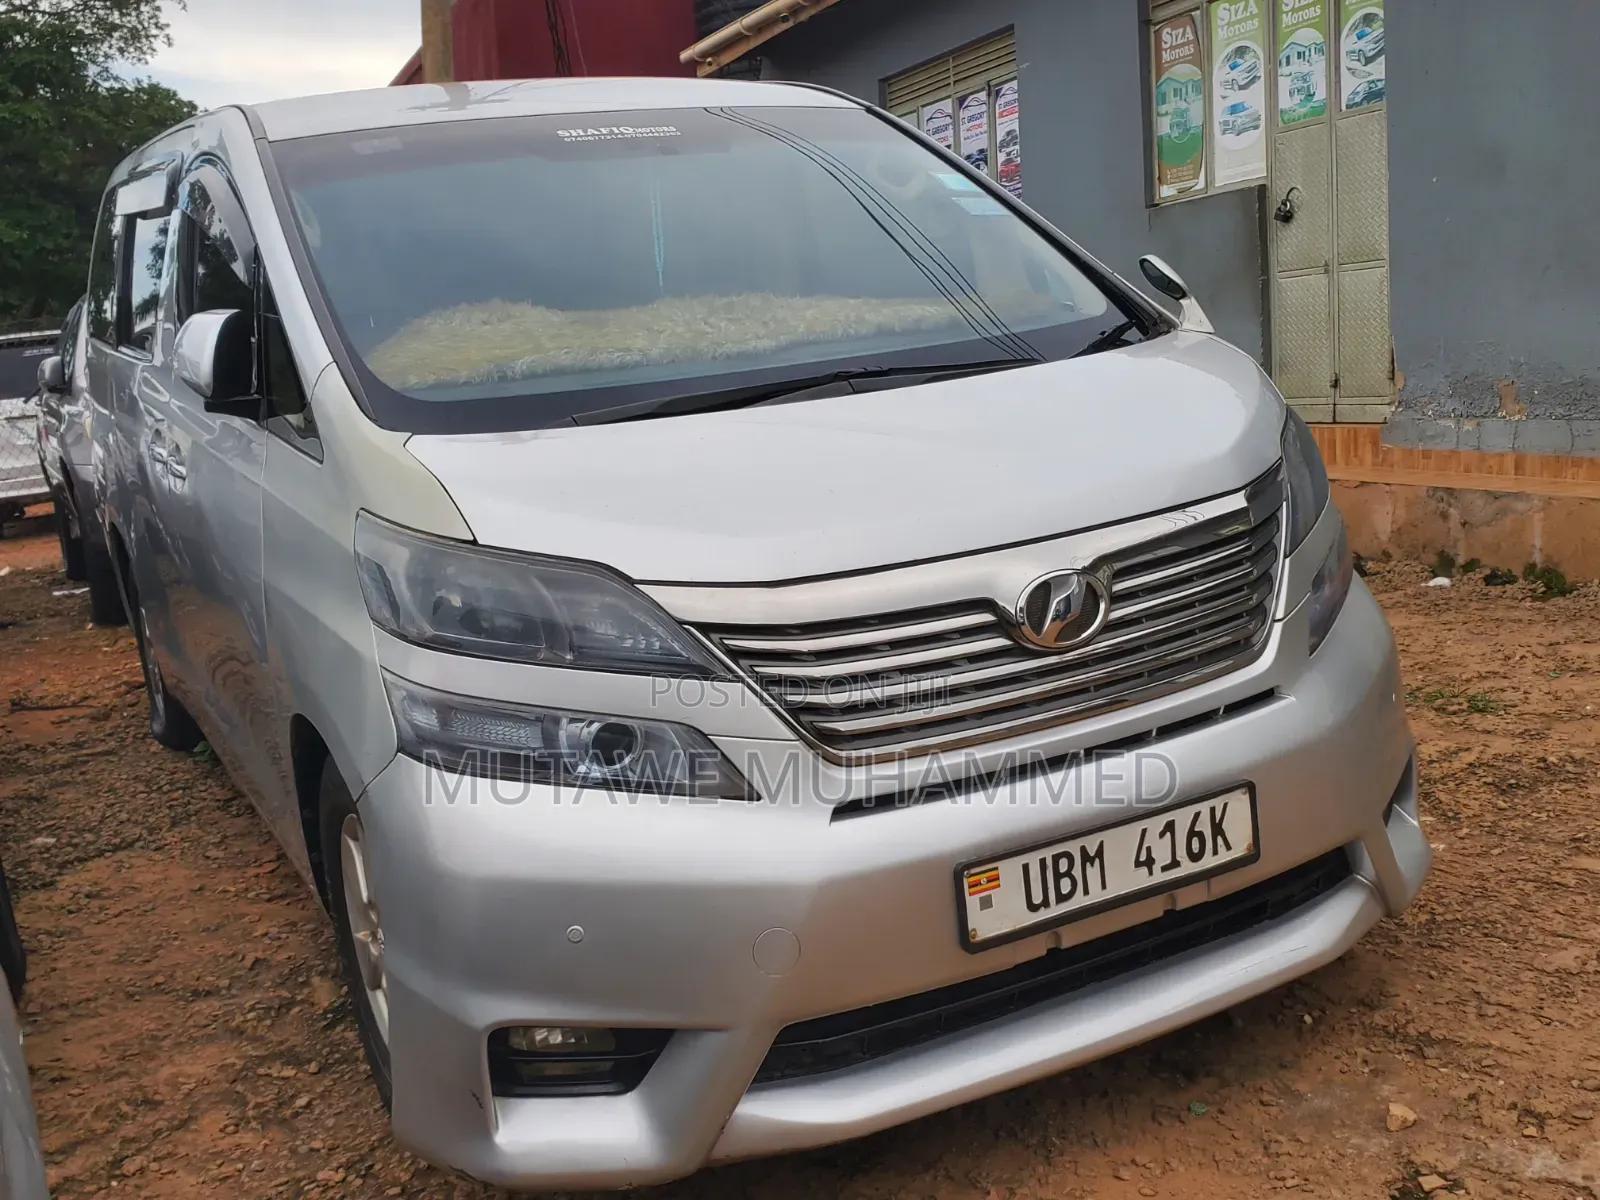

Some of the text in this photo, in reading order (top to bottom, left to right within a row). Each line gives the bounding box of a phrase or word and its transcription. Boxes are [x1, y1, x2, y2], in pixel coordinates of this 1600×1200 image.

[1217, 0, 1259, 27] SIZA
[1282, 5, 1321, 28] MOTORS
[1161, 24, 1194, 49] SIZA
[1217, 18, 1260, 41] MOTORS
[1161, 44, 1194, 64] MOTORS
[556, 126, 635, 137] SHAFIQ
[1022, 802, 1232, 913] UBM 416K
